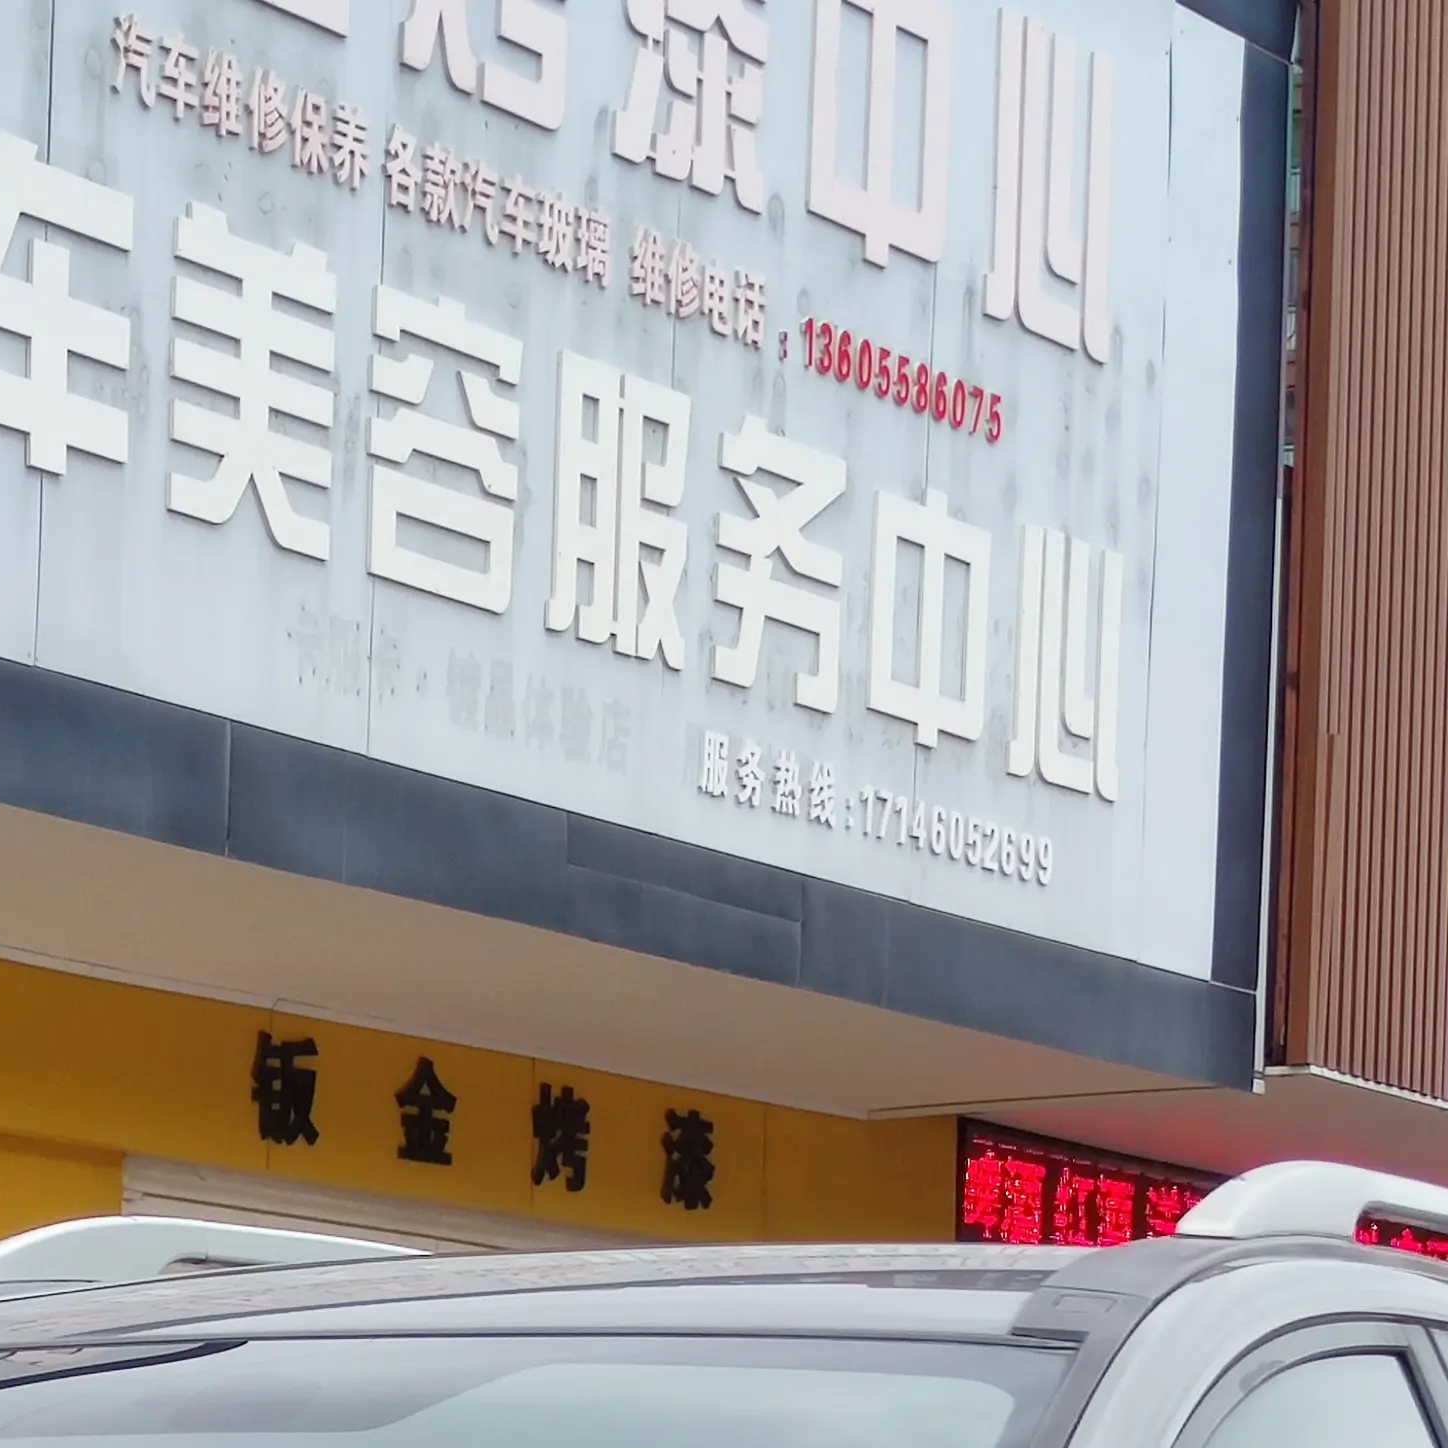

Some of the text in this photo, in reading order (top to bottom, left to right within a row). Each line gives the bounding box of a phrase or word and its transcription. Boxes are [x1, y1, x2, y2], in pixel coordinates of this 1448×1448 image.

[110, 12, 371, 191] 汽车维修保养
[383, 122, 612, 289] 各款汽车玻璃
[250, 1029, 716, 1212] 钣金烤漆
